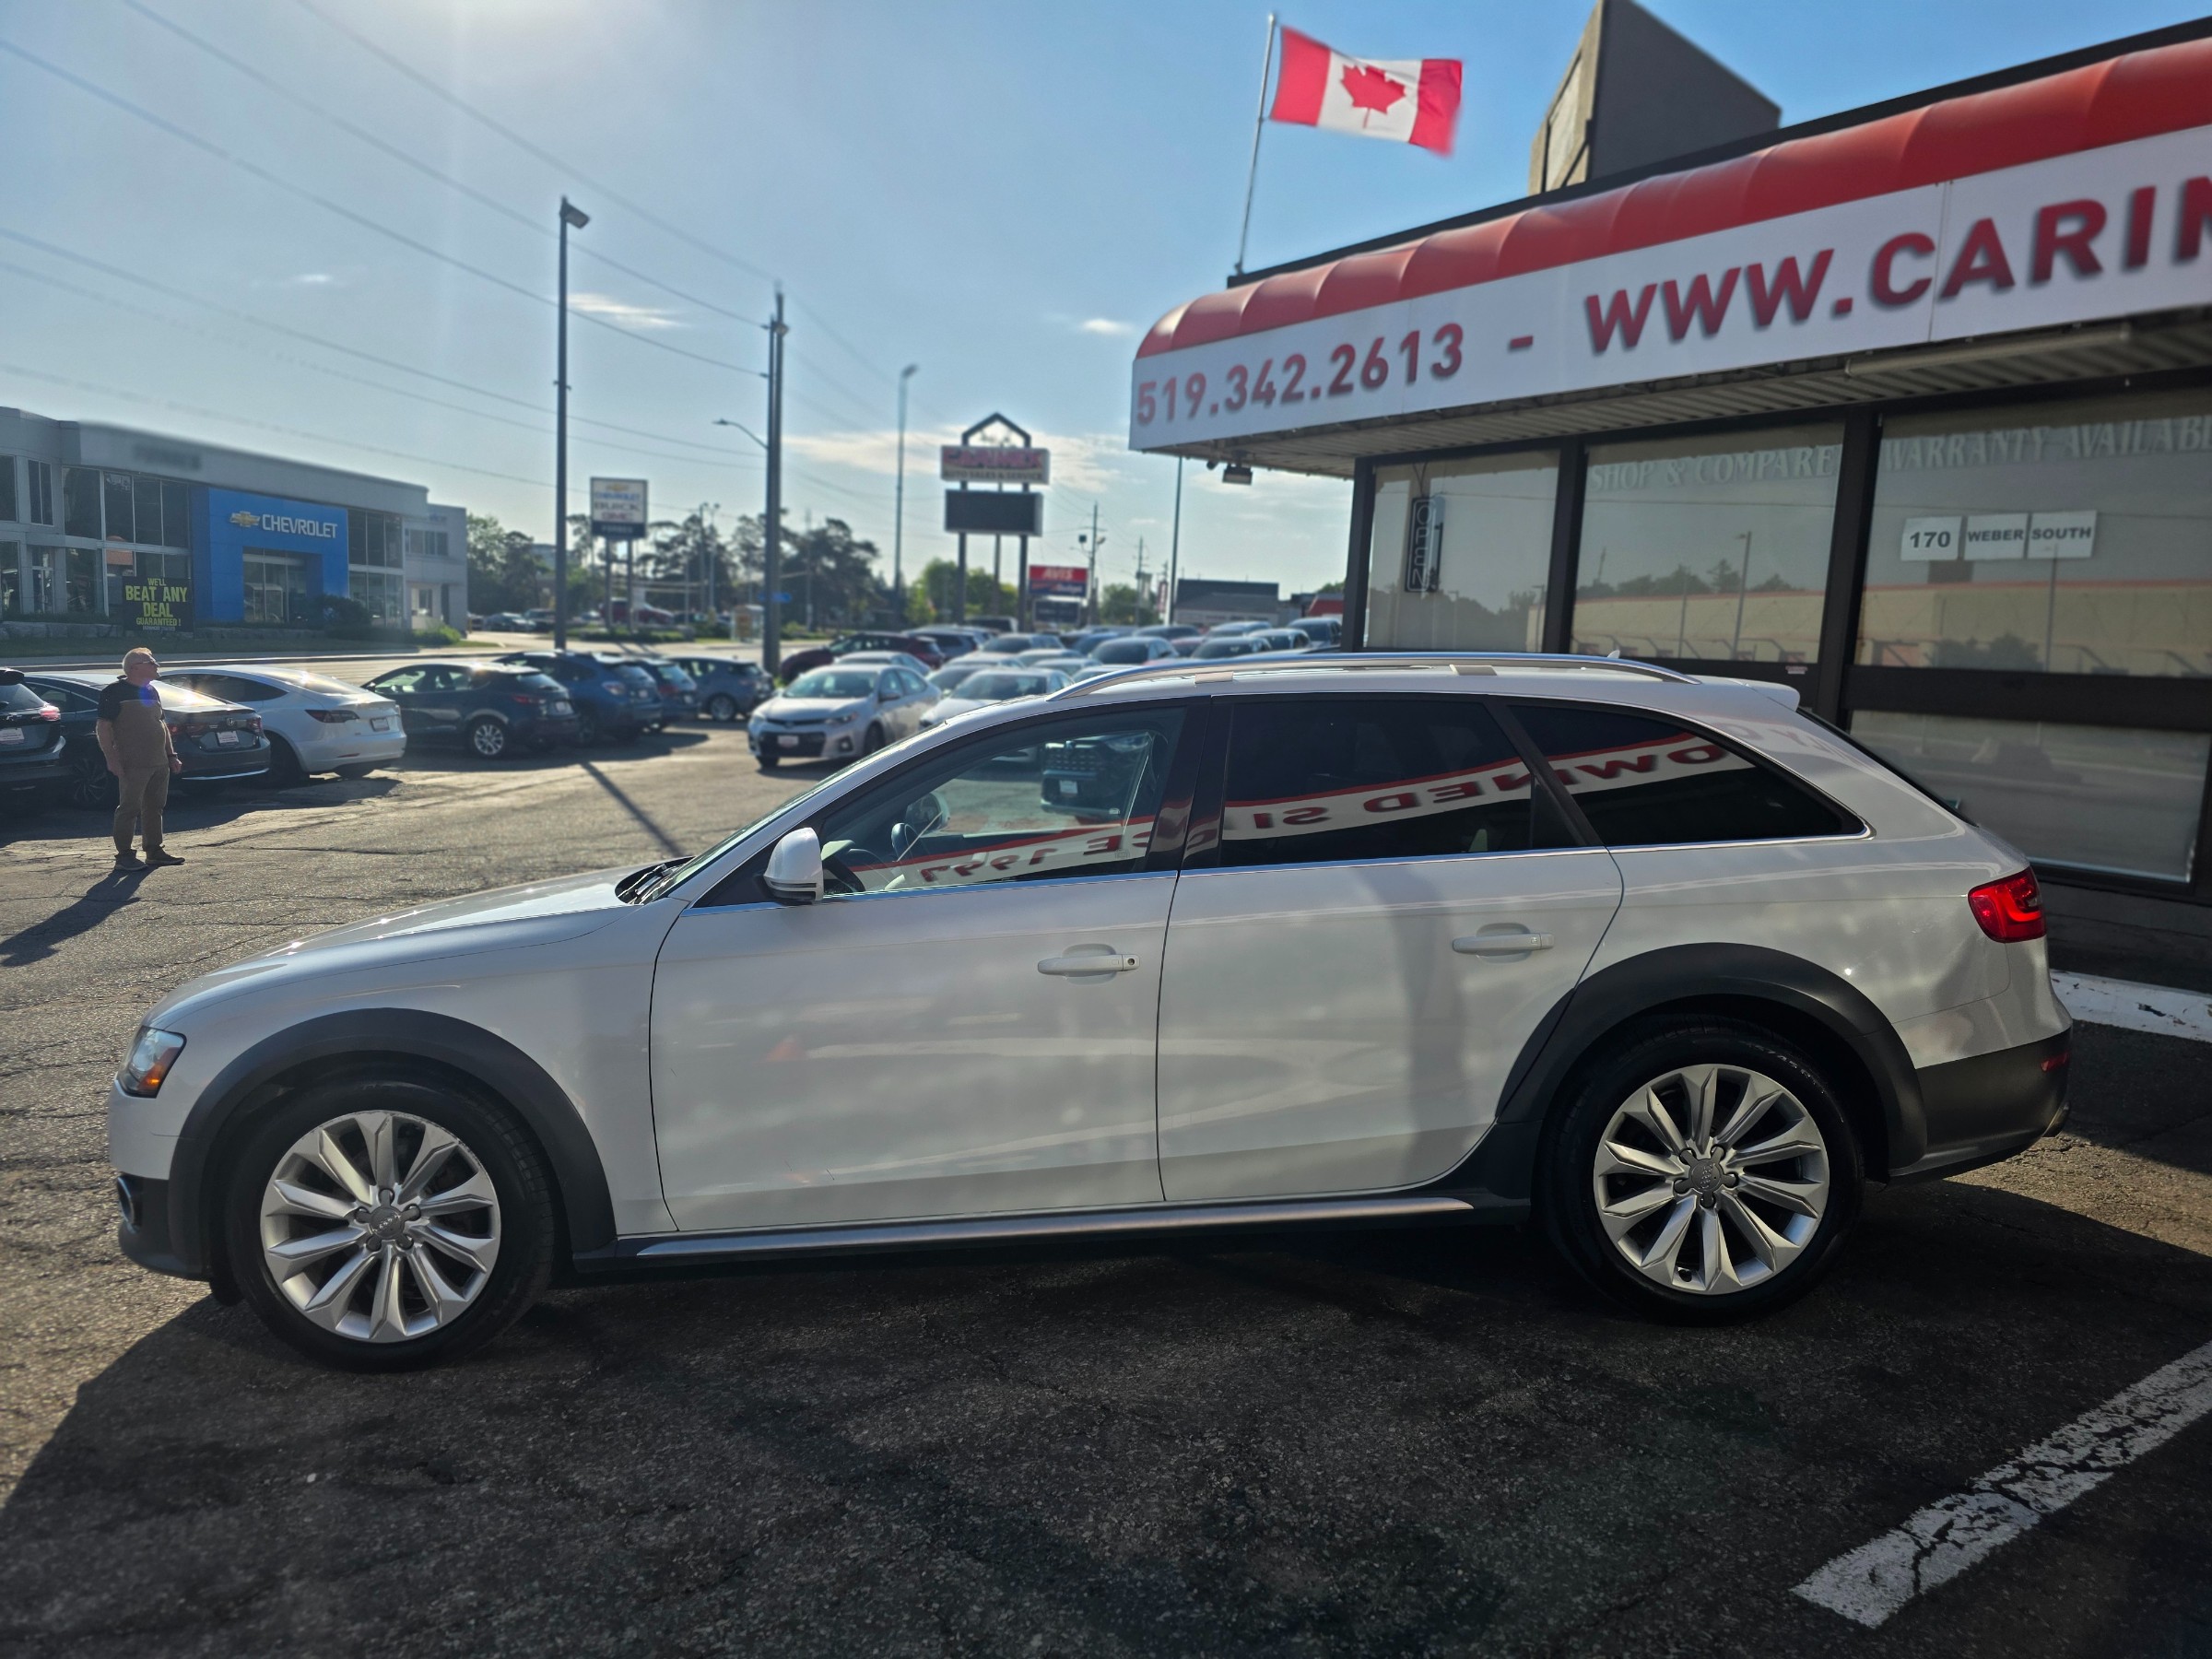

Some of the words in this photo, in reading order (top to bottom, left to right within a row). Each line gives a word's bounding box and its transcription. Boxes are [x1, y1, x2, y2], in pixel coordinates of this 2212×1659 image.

[1137, 322, 1464, 425] 519.342.2613
[1590, 460, 1655, 492] SHOP
[1665, 460, 1687, 487] &
[1696, 445, 1837, 483] COMPARE
[262, 513, 338, 539] CHEVROLET
[1910, 531, 1951, 548] 170
[1968, 529, 2024, 543] WEBER
[2031, 526, 2092, 540] SOUTH
[1411, 503, 1433, 588] OPEN
[125, 585, 157, 602] BEAT
[162, 586, 188, 603] ANY
[143, 602, 173, 618] DEAL
